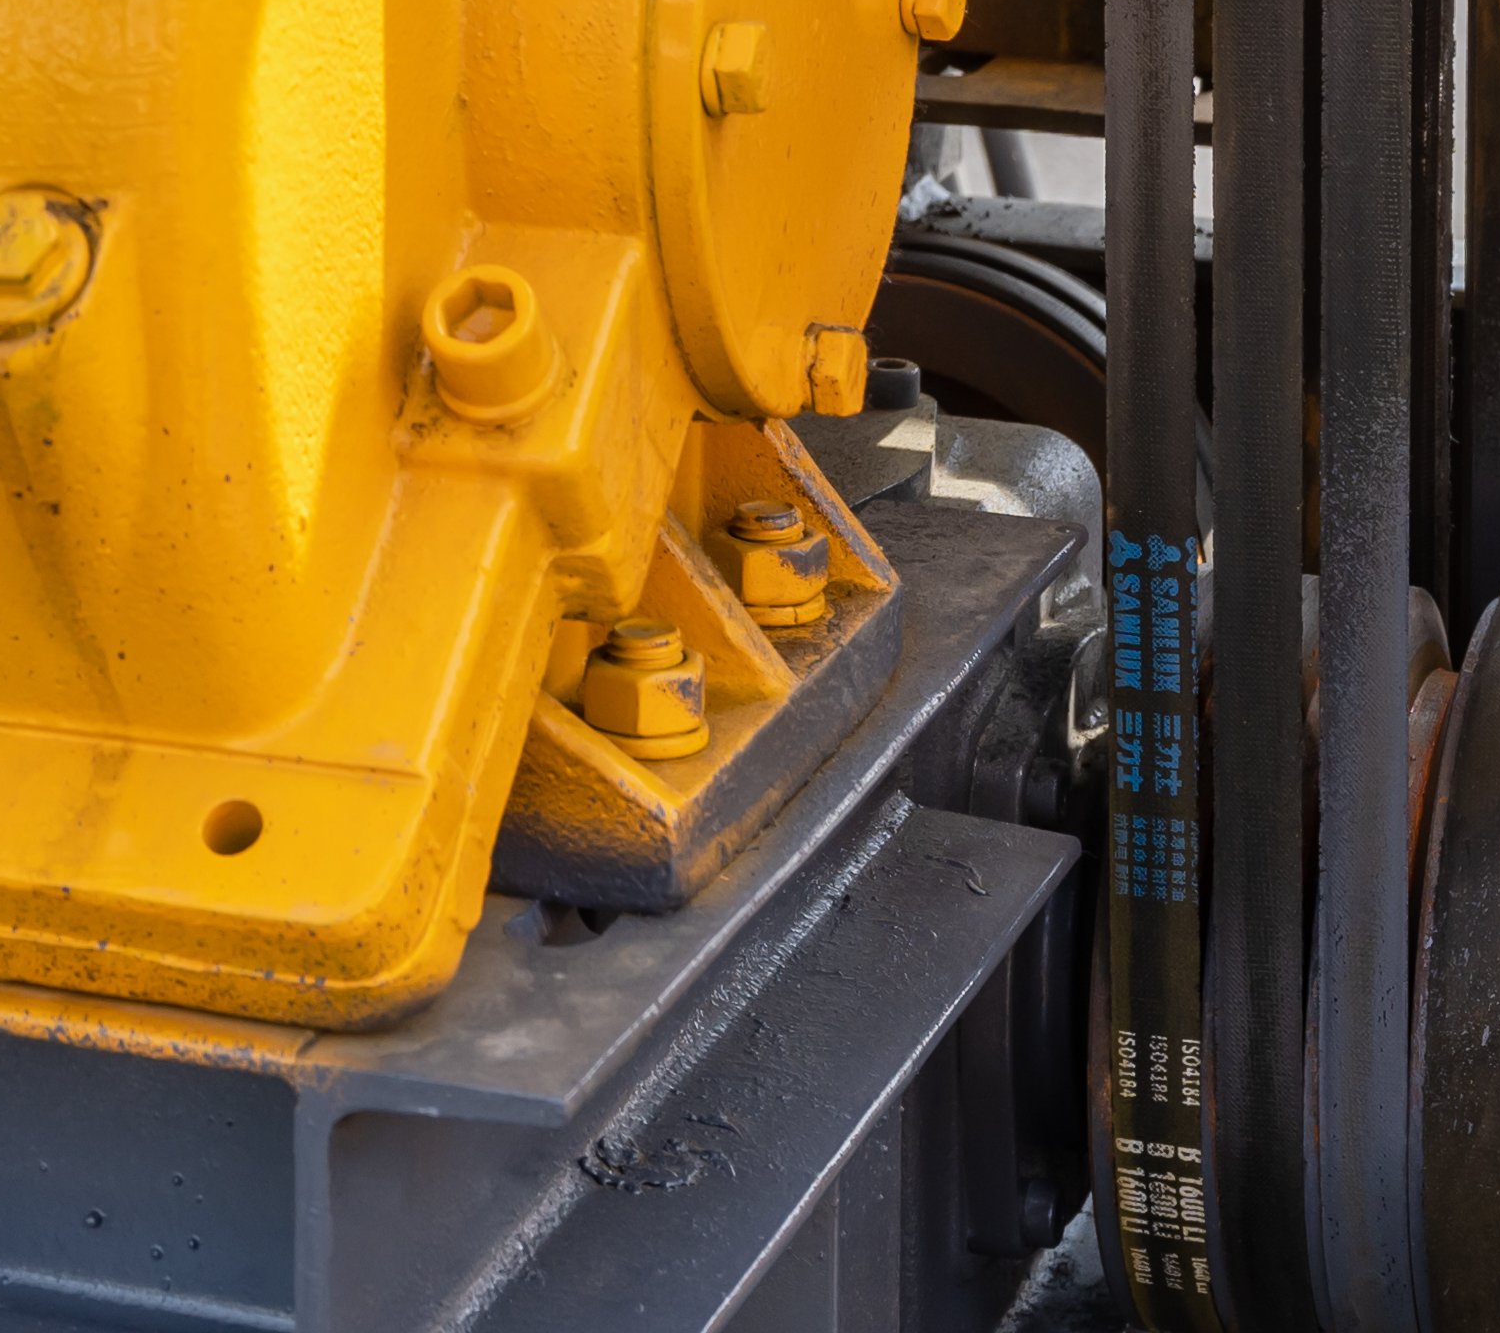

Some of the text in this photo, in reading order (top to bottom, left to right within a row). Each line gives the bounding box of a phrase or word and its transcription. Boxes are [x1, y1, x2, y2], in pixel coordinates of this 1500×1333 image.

[1151, 576, 1182, 694] SANLUX
[1113, 572, 1144, 793] SANLUX 三力士
[1154, 712, 1183, 797] 三力士
[1117, 1030, 1138, 1099] ISO4184
[1181, 1038, 1201, 1107] ISO4184
[1115, 1137, 1146, 1156] B
[1117, 1165, 1149, 1215] 1600
